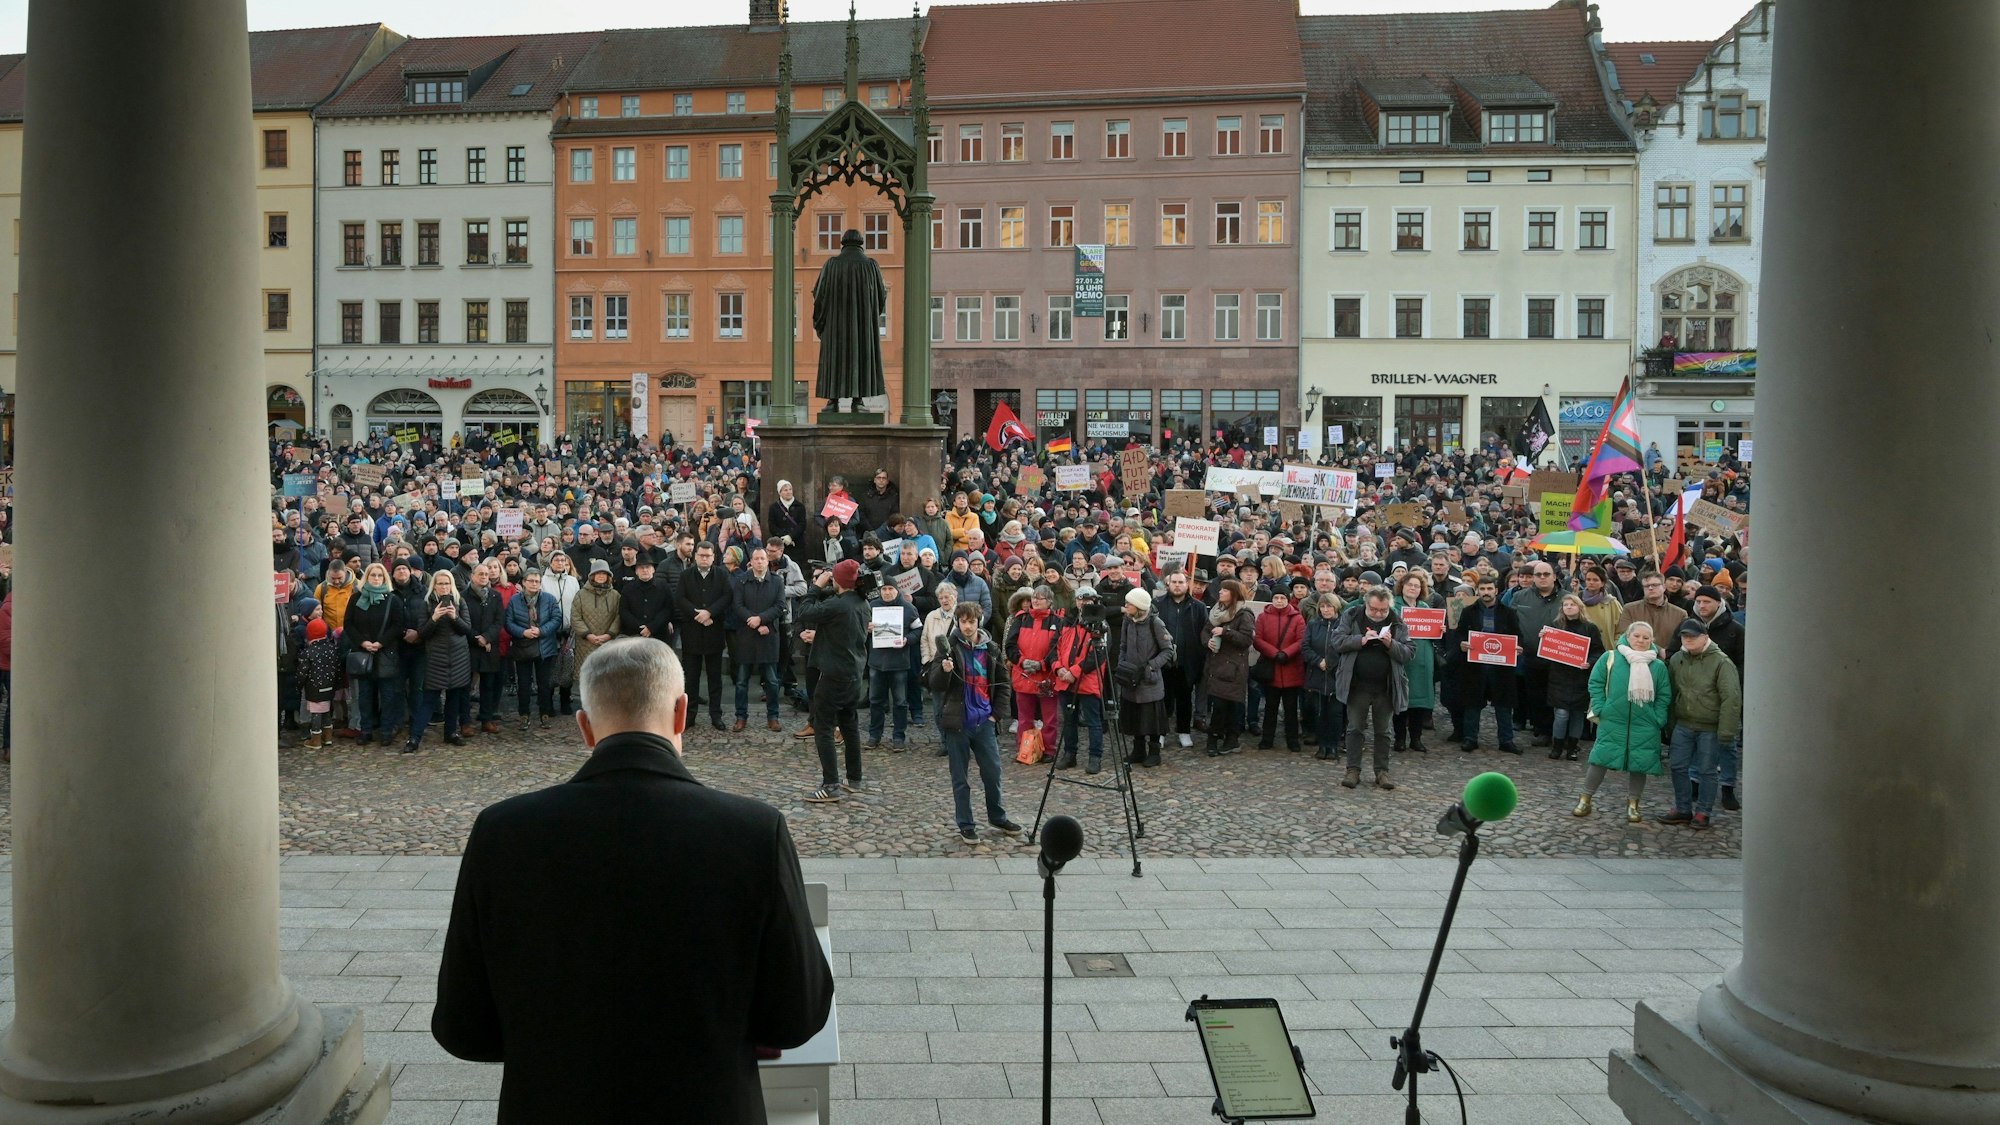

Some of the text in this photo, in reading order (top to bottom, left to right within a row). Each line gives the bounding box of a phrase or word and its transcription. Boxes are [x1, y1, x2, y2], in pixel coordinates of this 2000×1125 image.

[1075, 277, 1104, 285] 27.01.24
[1075, 291, 1103, 299] DEMO
[1702, 353, 1743, 372] Respect
[1371, 373, 1498, 384] BRILLEN-WAGNER
[1037, 411, 1067, 419] WITTEN
[1564, 405, 1604, 418] COCO
[1038, 418, 1060, 426] BERG
[1123, 451, 1146, 466] AfD
[1124, 466, 1145, 478] TUT
[1124, 478, 1148, 491] WEH
[1286, 470, 1298, 484] NIE
[1313, 470, 1354, 489] DIKTATUR!
[1321, 486, 1354, 504] VIELFALT
[1178, 523, 1217, 532] DEMOKRATIE
[1178, 532, 1215, 541] BEWAHREN!
[1485, 642, 1500, 650] STOP
[1544, 636, 1585, 651] MENSCHENRECHTE
[1542, 646, 1584, 661] RECHTE MENSCHEN
